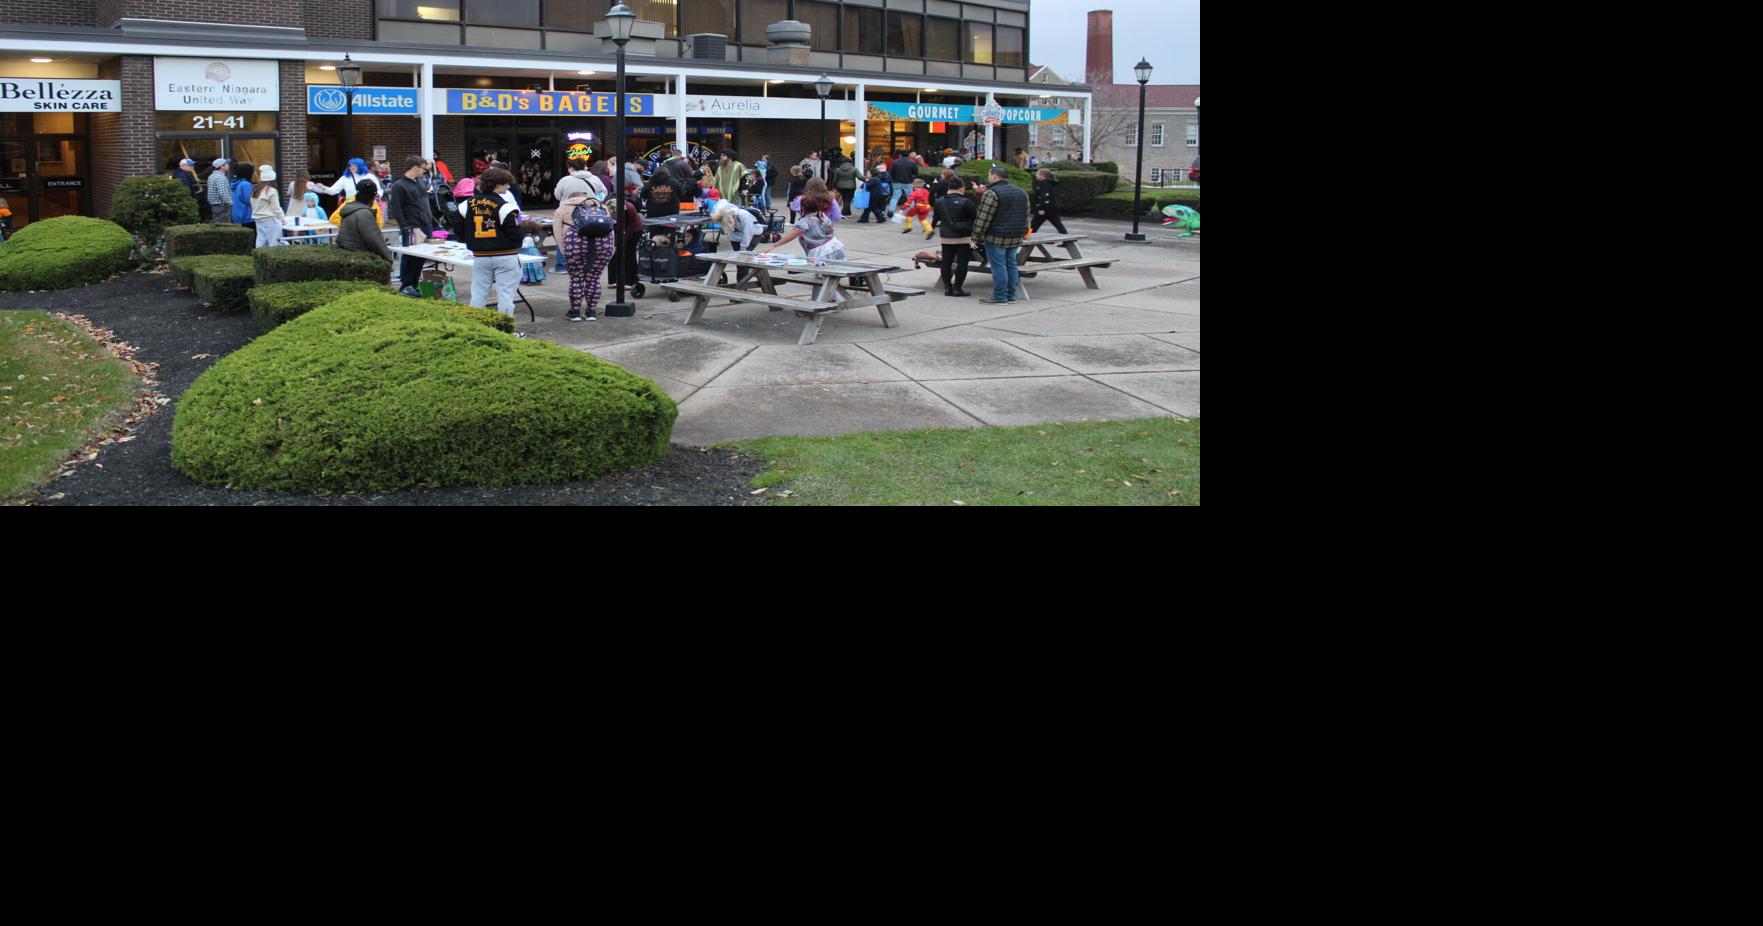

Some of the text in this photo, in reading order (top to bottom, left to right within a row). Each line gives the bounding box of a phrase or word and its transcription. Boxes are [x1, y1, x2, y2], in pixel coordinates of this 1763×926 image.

[168, 83, 267, 94] Eastern Niagara
[34, 102, 108, 110] SKIN CARE
[183, 95, 254, 106] United Way
[351, 94, 414, 108] Allstate
[462, 93, 642, 113] B&D's BAGES
[711, 98, 760, 111] Aurelia
[908, 105, 959, 119] GOURMET
[1001, 109, 1041, 121] POPCORN
[192, 115, 244, 129] 21-41
[473, 216, 497, 238] L
